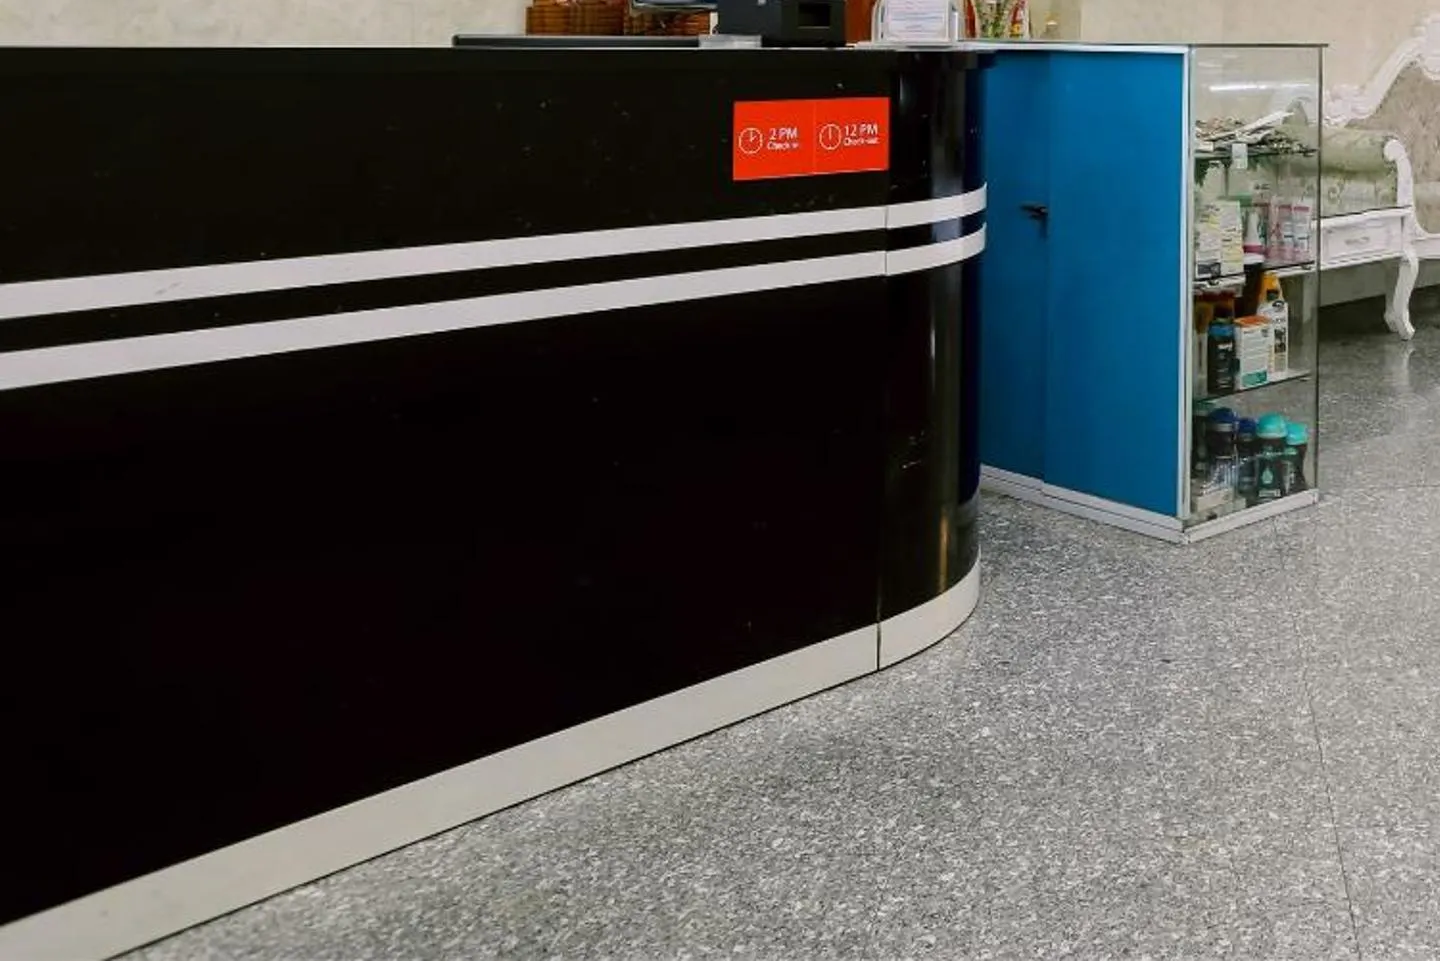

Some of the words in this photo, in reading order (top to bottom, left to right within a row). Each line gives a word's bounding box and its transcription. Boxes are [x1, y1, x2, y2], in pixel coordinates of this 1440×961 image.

[778, 127, 798, 140] PM
[844, 125, 857, 139] 12
[859, 123, 879, 136] PM
